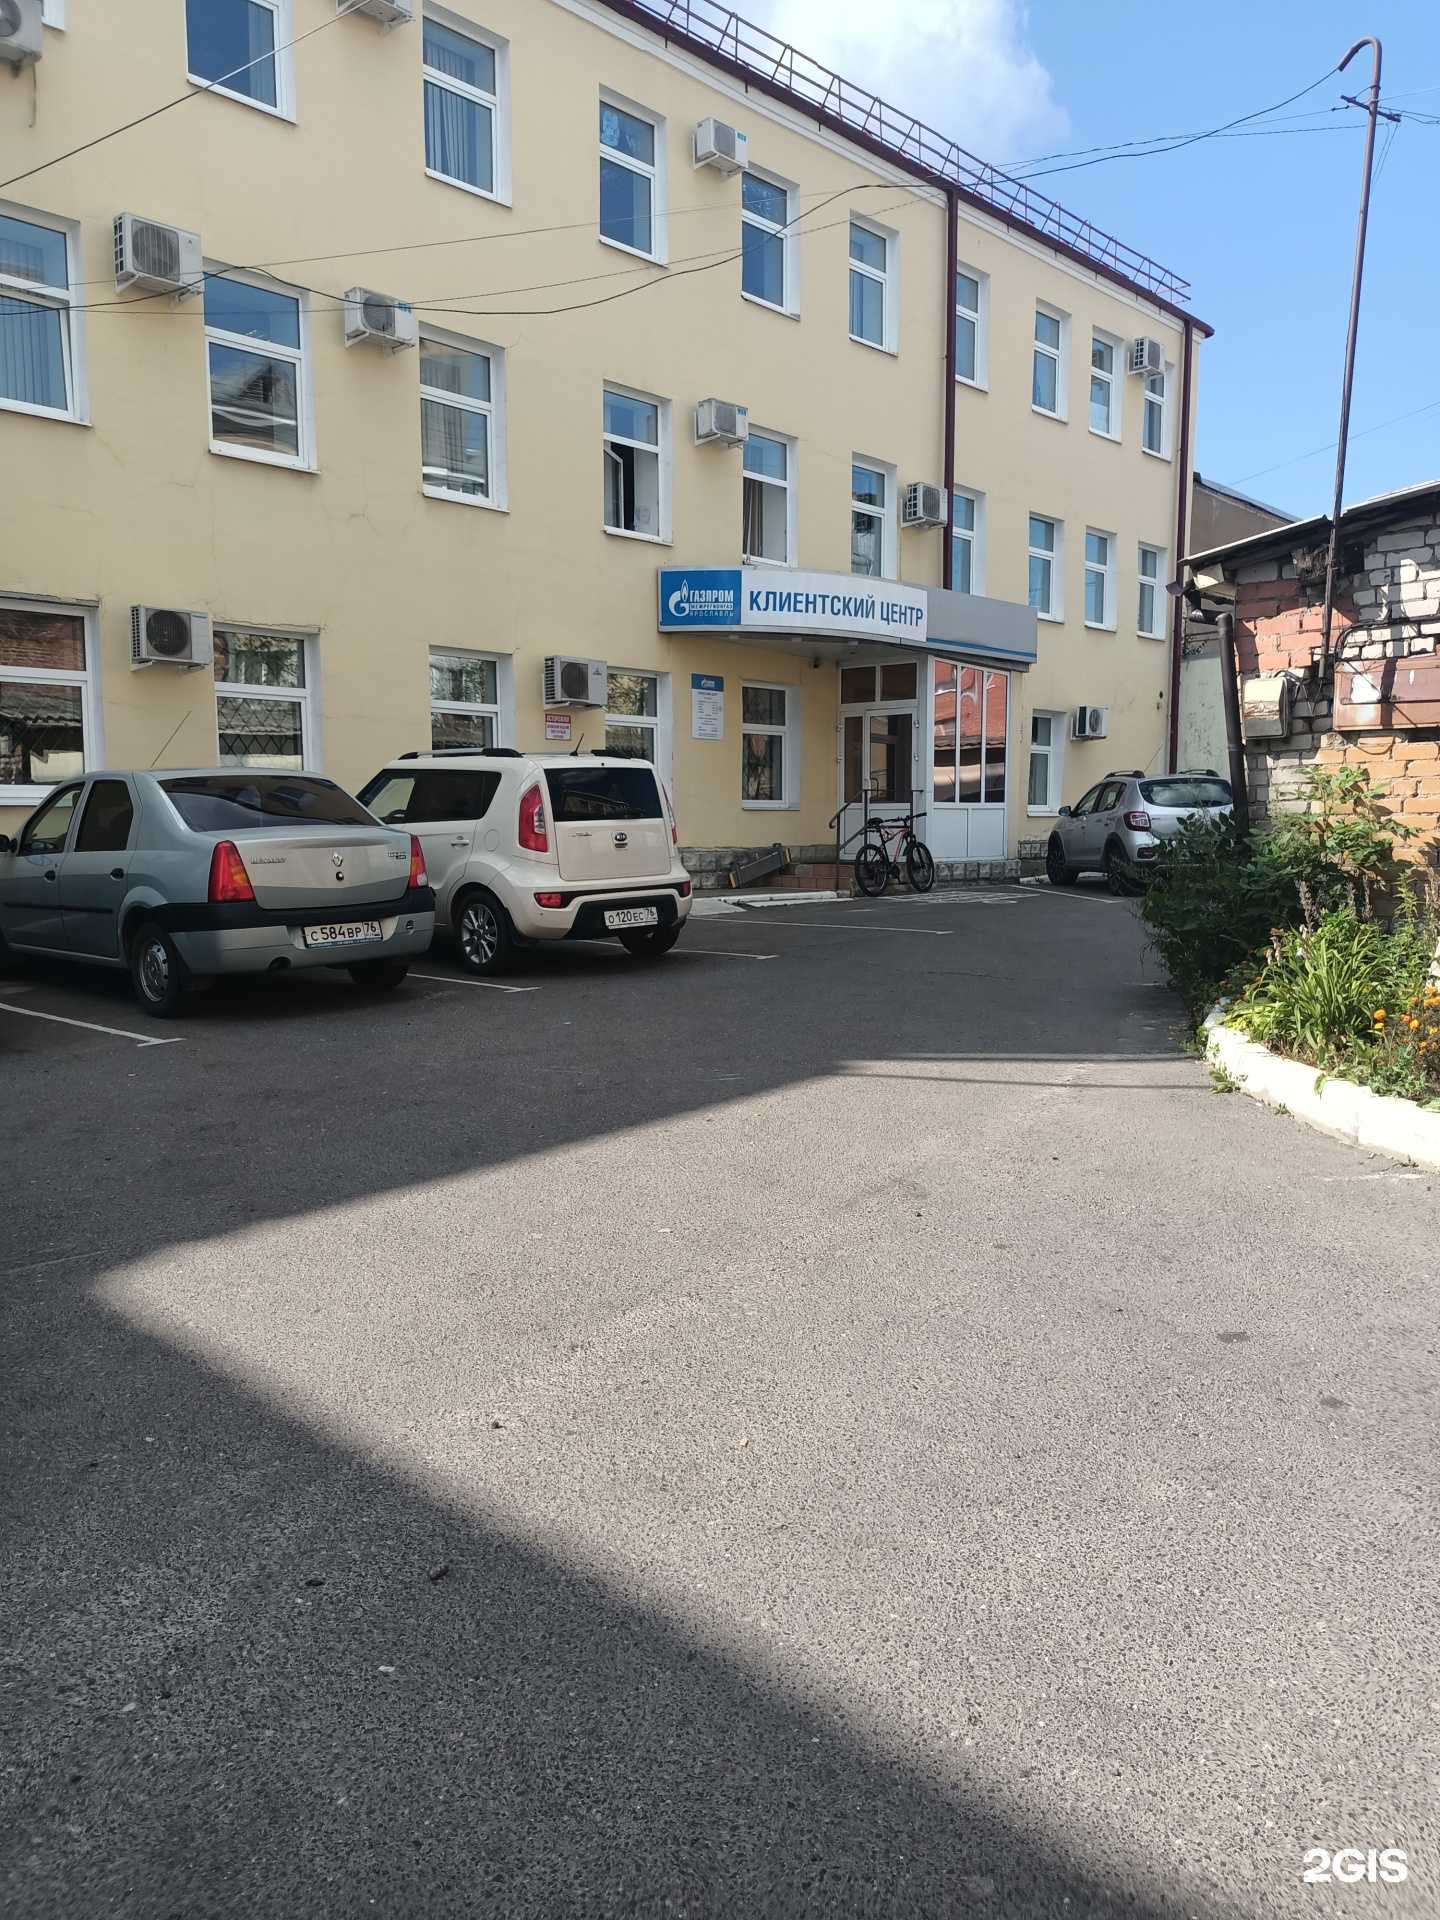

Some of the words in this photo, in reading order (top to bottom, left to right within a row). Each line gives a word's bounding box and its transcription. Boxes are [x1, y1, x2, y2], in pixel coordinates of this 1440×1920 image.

[690, 590, 734, 602] ГАЗПРОМ
[749, 591, 875, 620] КЛИЕНТСКИЙ
[880, 601, 924, 627] ЦЕНТР
